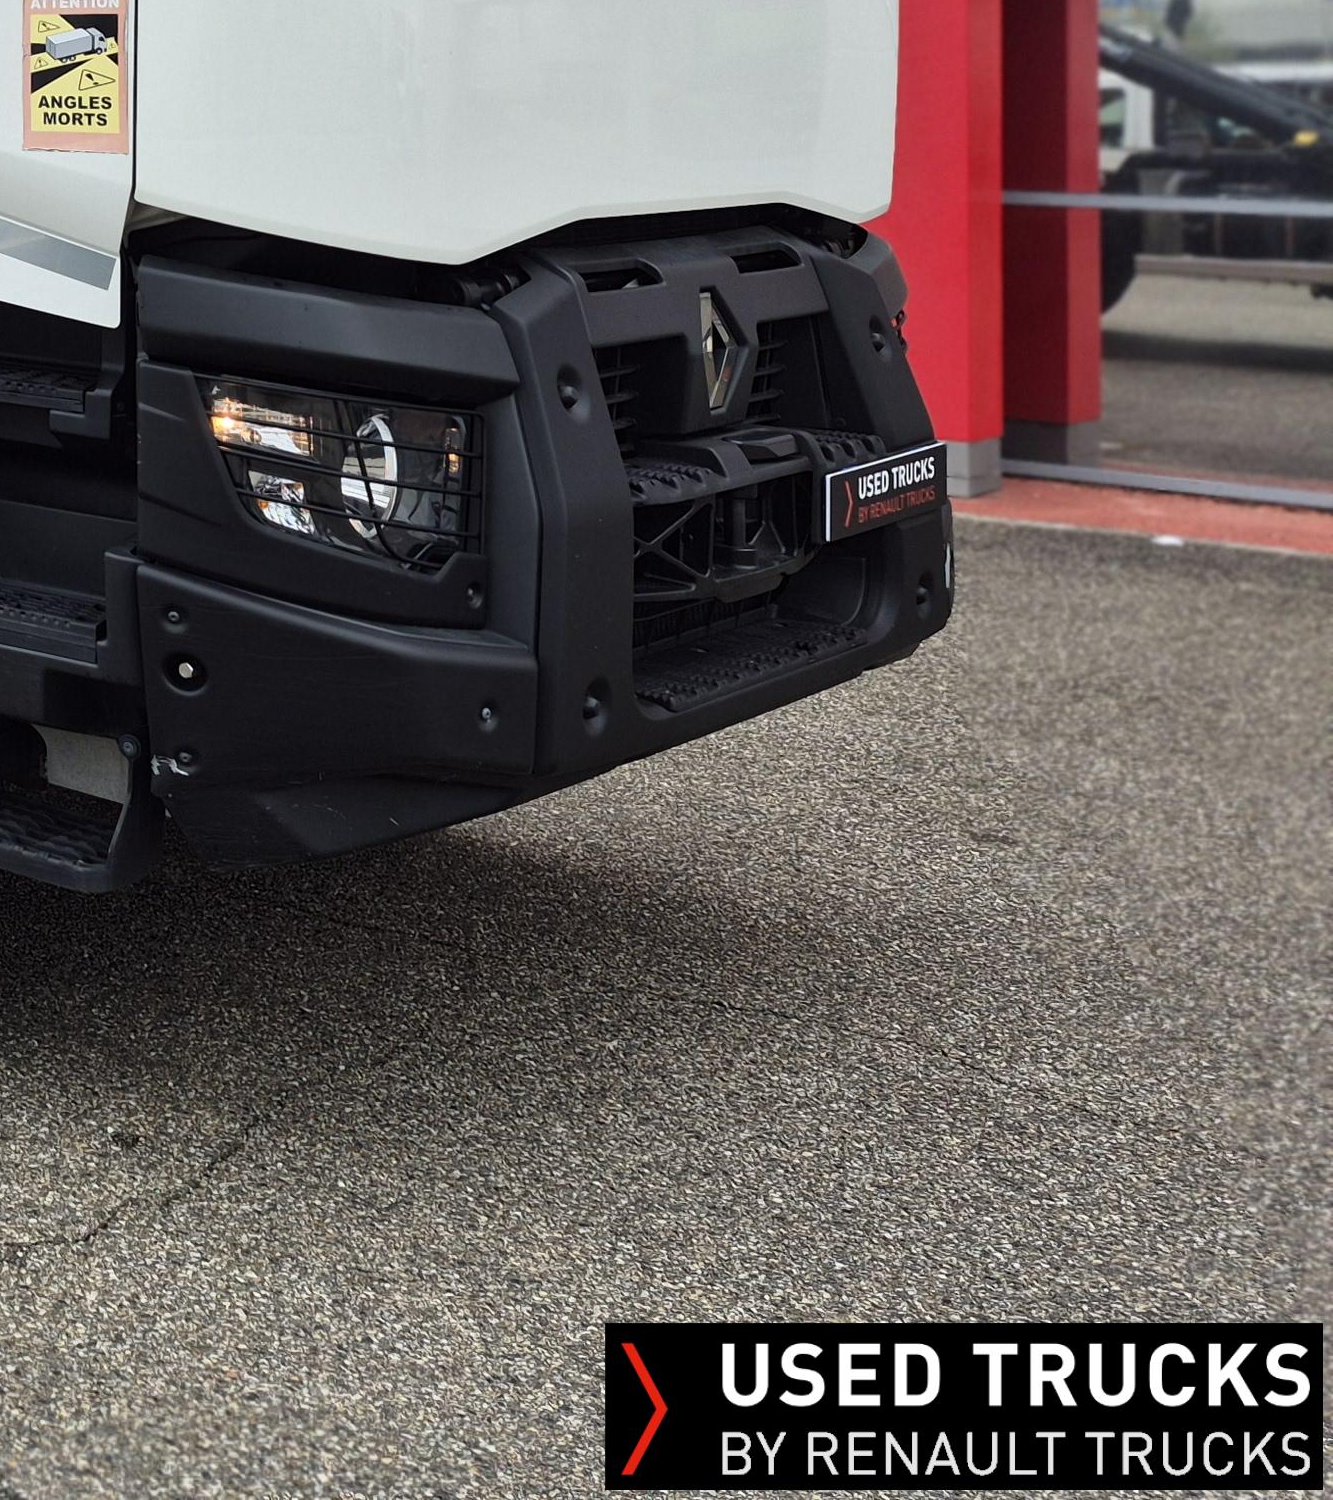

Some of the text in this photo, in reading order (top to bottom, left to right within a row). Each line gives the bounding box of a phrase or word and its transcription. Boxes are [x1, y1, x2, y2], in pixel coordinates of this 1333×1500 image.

[38, 96, 112, 110] ANGLES
[43, 112, 108, 126] MORTS
[858, 457, 935, 500] USED TRUCKS
[858, 505, 869, 524] BY
